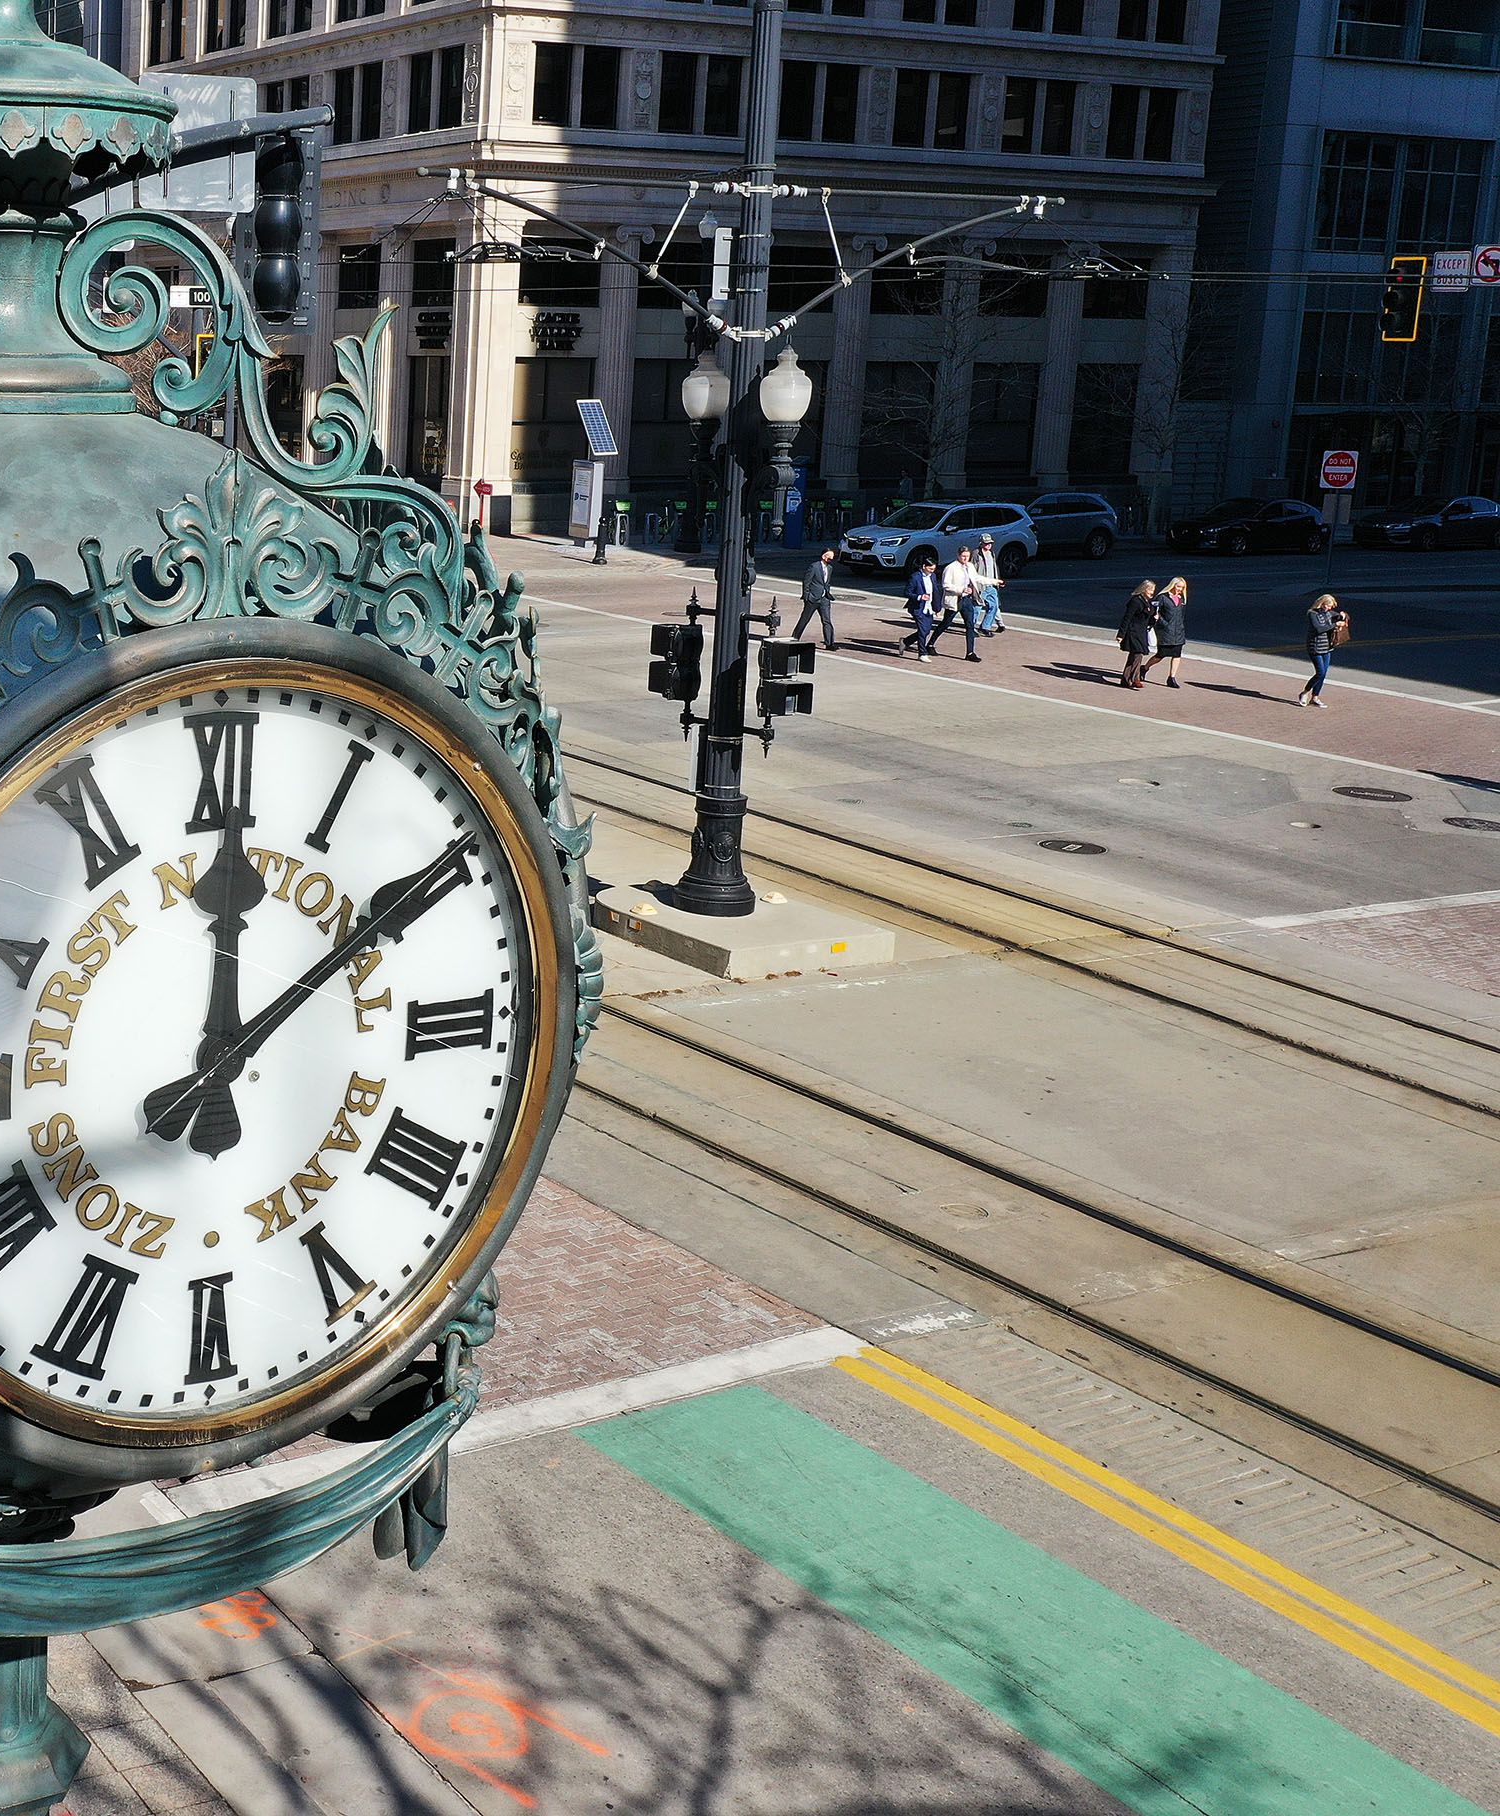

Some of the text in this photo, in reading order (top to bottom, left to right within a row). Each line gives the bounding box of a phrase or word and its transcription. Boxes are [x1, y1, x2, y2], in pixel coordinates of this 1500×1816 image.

[1436, 258, 1467, 270] EXCEPT
[193, 291, 211, 303] 100
[24, 847, 392, 1259] ZIONS FIRST NTIONAL BANK
